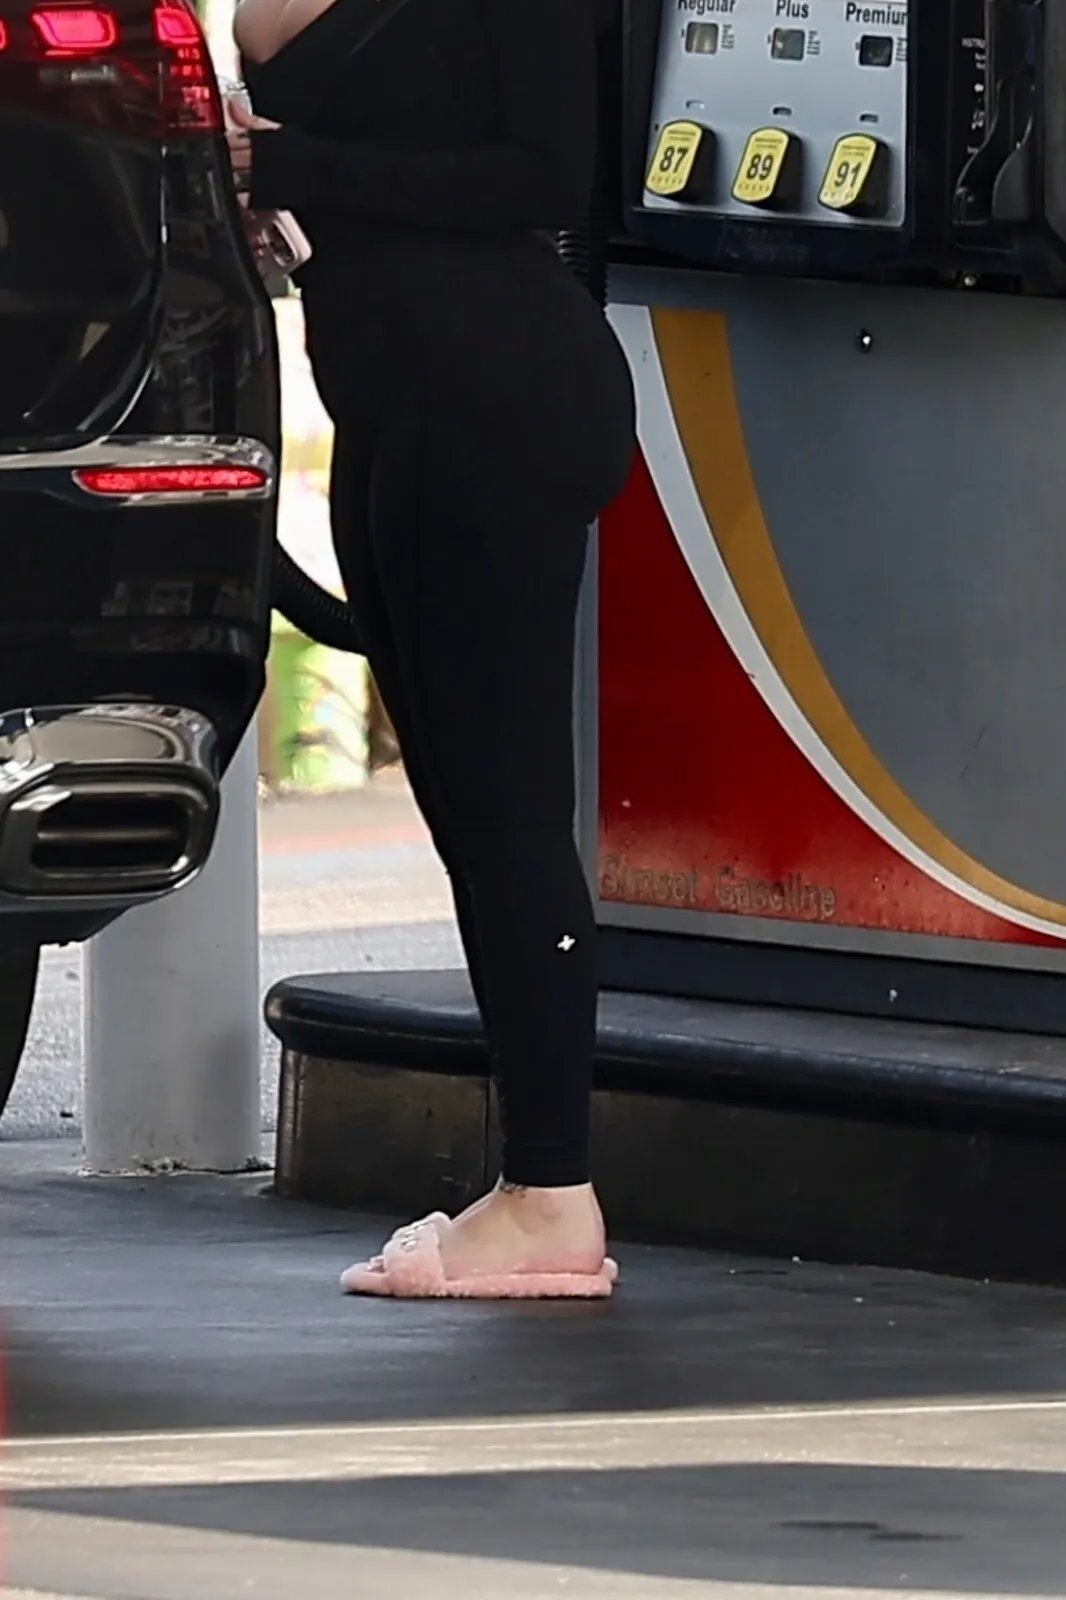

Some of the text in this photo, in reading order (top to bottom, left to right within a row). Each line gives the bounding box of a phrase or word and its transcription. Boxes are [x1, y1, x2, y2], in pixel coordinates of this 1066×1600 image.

[659, 146, 688, 174] 87
[746, 153, 774, 182] 89
[834, 160, 863, 189] 91
[601, 853, 837, 918] Sunset Gasoline
